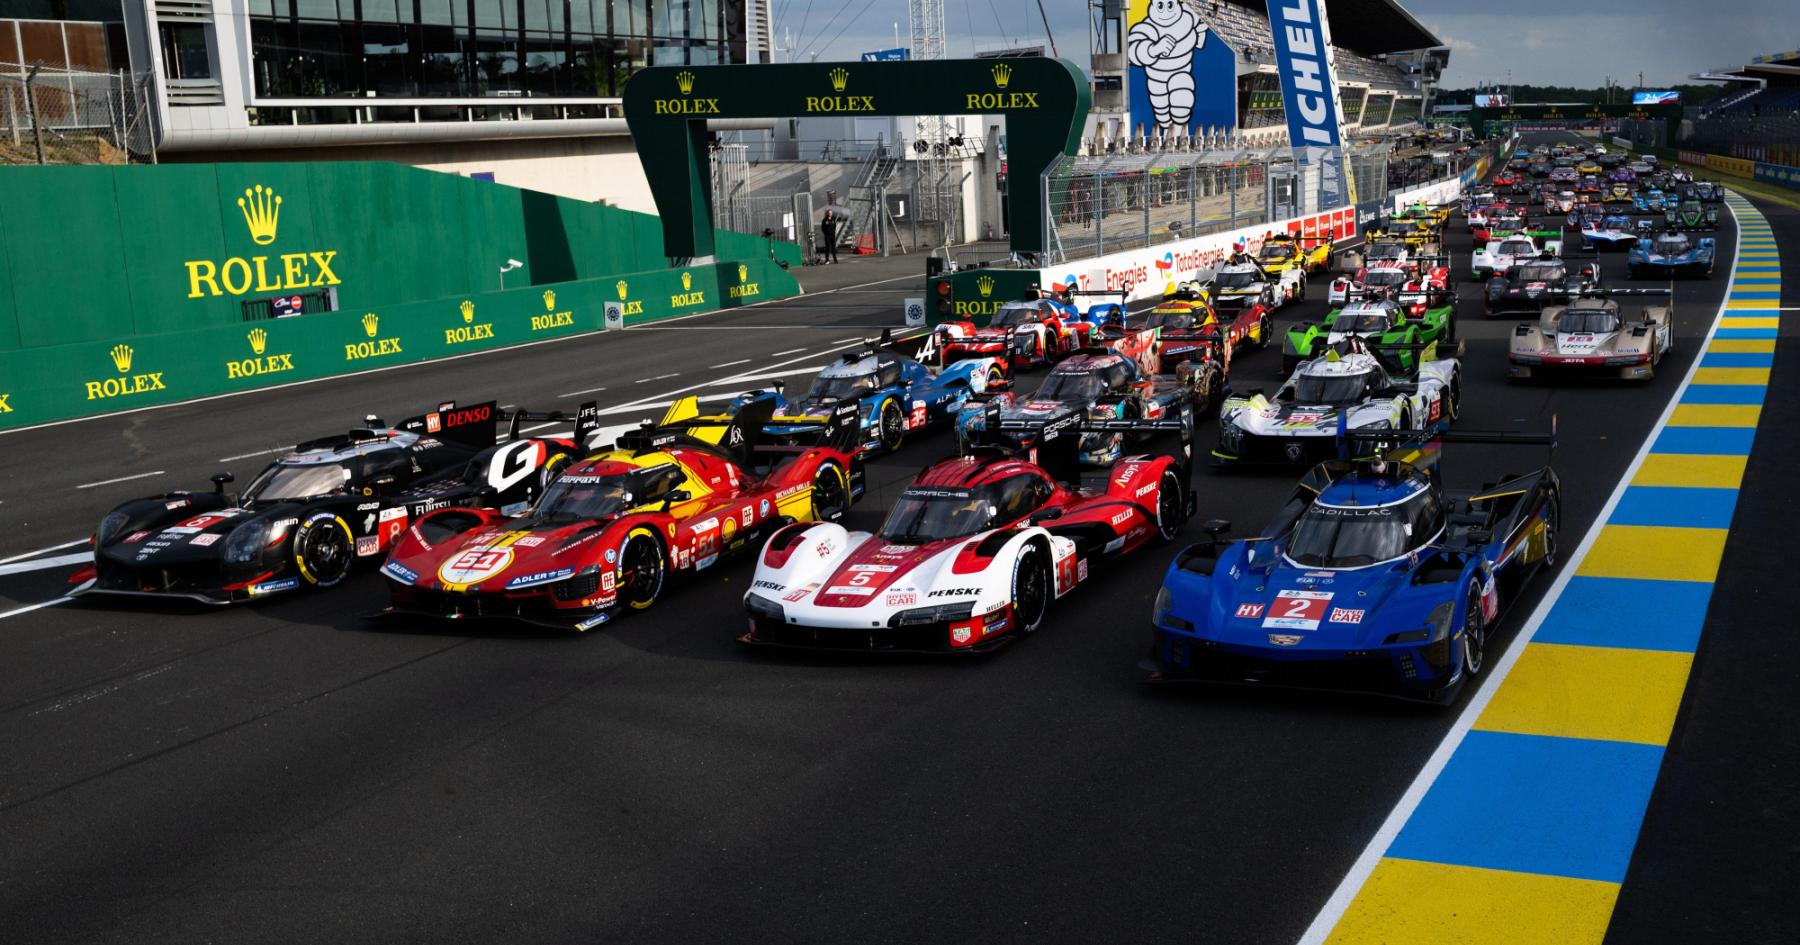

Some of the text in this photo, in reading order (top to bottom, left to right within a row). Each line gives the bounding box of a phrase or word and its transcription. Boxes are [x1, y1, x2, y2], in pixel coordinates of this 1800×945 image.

[656, 99, 718, 112] ROLEX
[808, 97, 873, 111] ROLEX
[968, 94, 1037, 108] ROLEX
[1174, 245, 1225, 273] TotalEnergies
[186, 251, 340, 298] ROLEX
[731, 284, 758, 296] ROLEX
[672, 292, 703, 306] ROLEX
[622, 302, 641, 315] LEX
[532, 312, 572, 329] ROLEX
[446, 324, 493, 344] ROLEX
[346, 338, 400, 359] ROLEX
[228, 352, 292, 378] ROLEX
[87, 370, 164, 399] ROLEX
[447, 406, 490, 428] DENSO
[579, 406, 596, 418] JFE
[428, 416, 440, 429] HY
[1043, 413, 1081, 434] PORSCHE
[776, 486, 796, 500] RICHARD
[904, 490, 969, 498] PORSCHE
[1310, 507, 1392, 516] CADILLAC
[391, 523, 401, 545] 8
[357, 545, 379, 557] CAR
[459, 552, 499, 569] 51
[512, 573, 547, 585] ADLER
[849, 572, 875, 586] 5
[1063, 560, 1072, 586] 5
[754, 580, 787, 592] PENSKE
[927, 588, 984, 598] PENSKE
[1237, 605, 1263, 616] HY
[1283, 599, 1310, 618] 2
[1331, 614, 1361, 622] CAR
